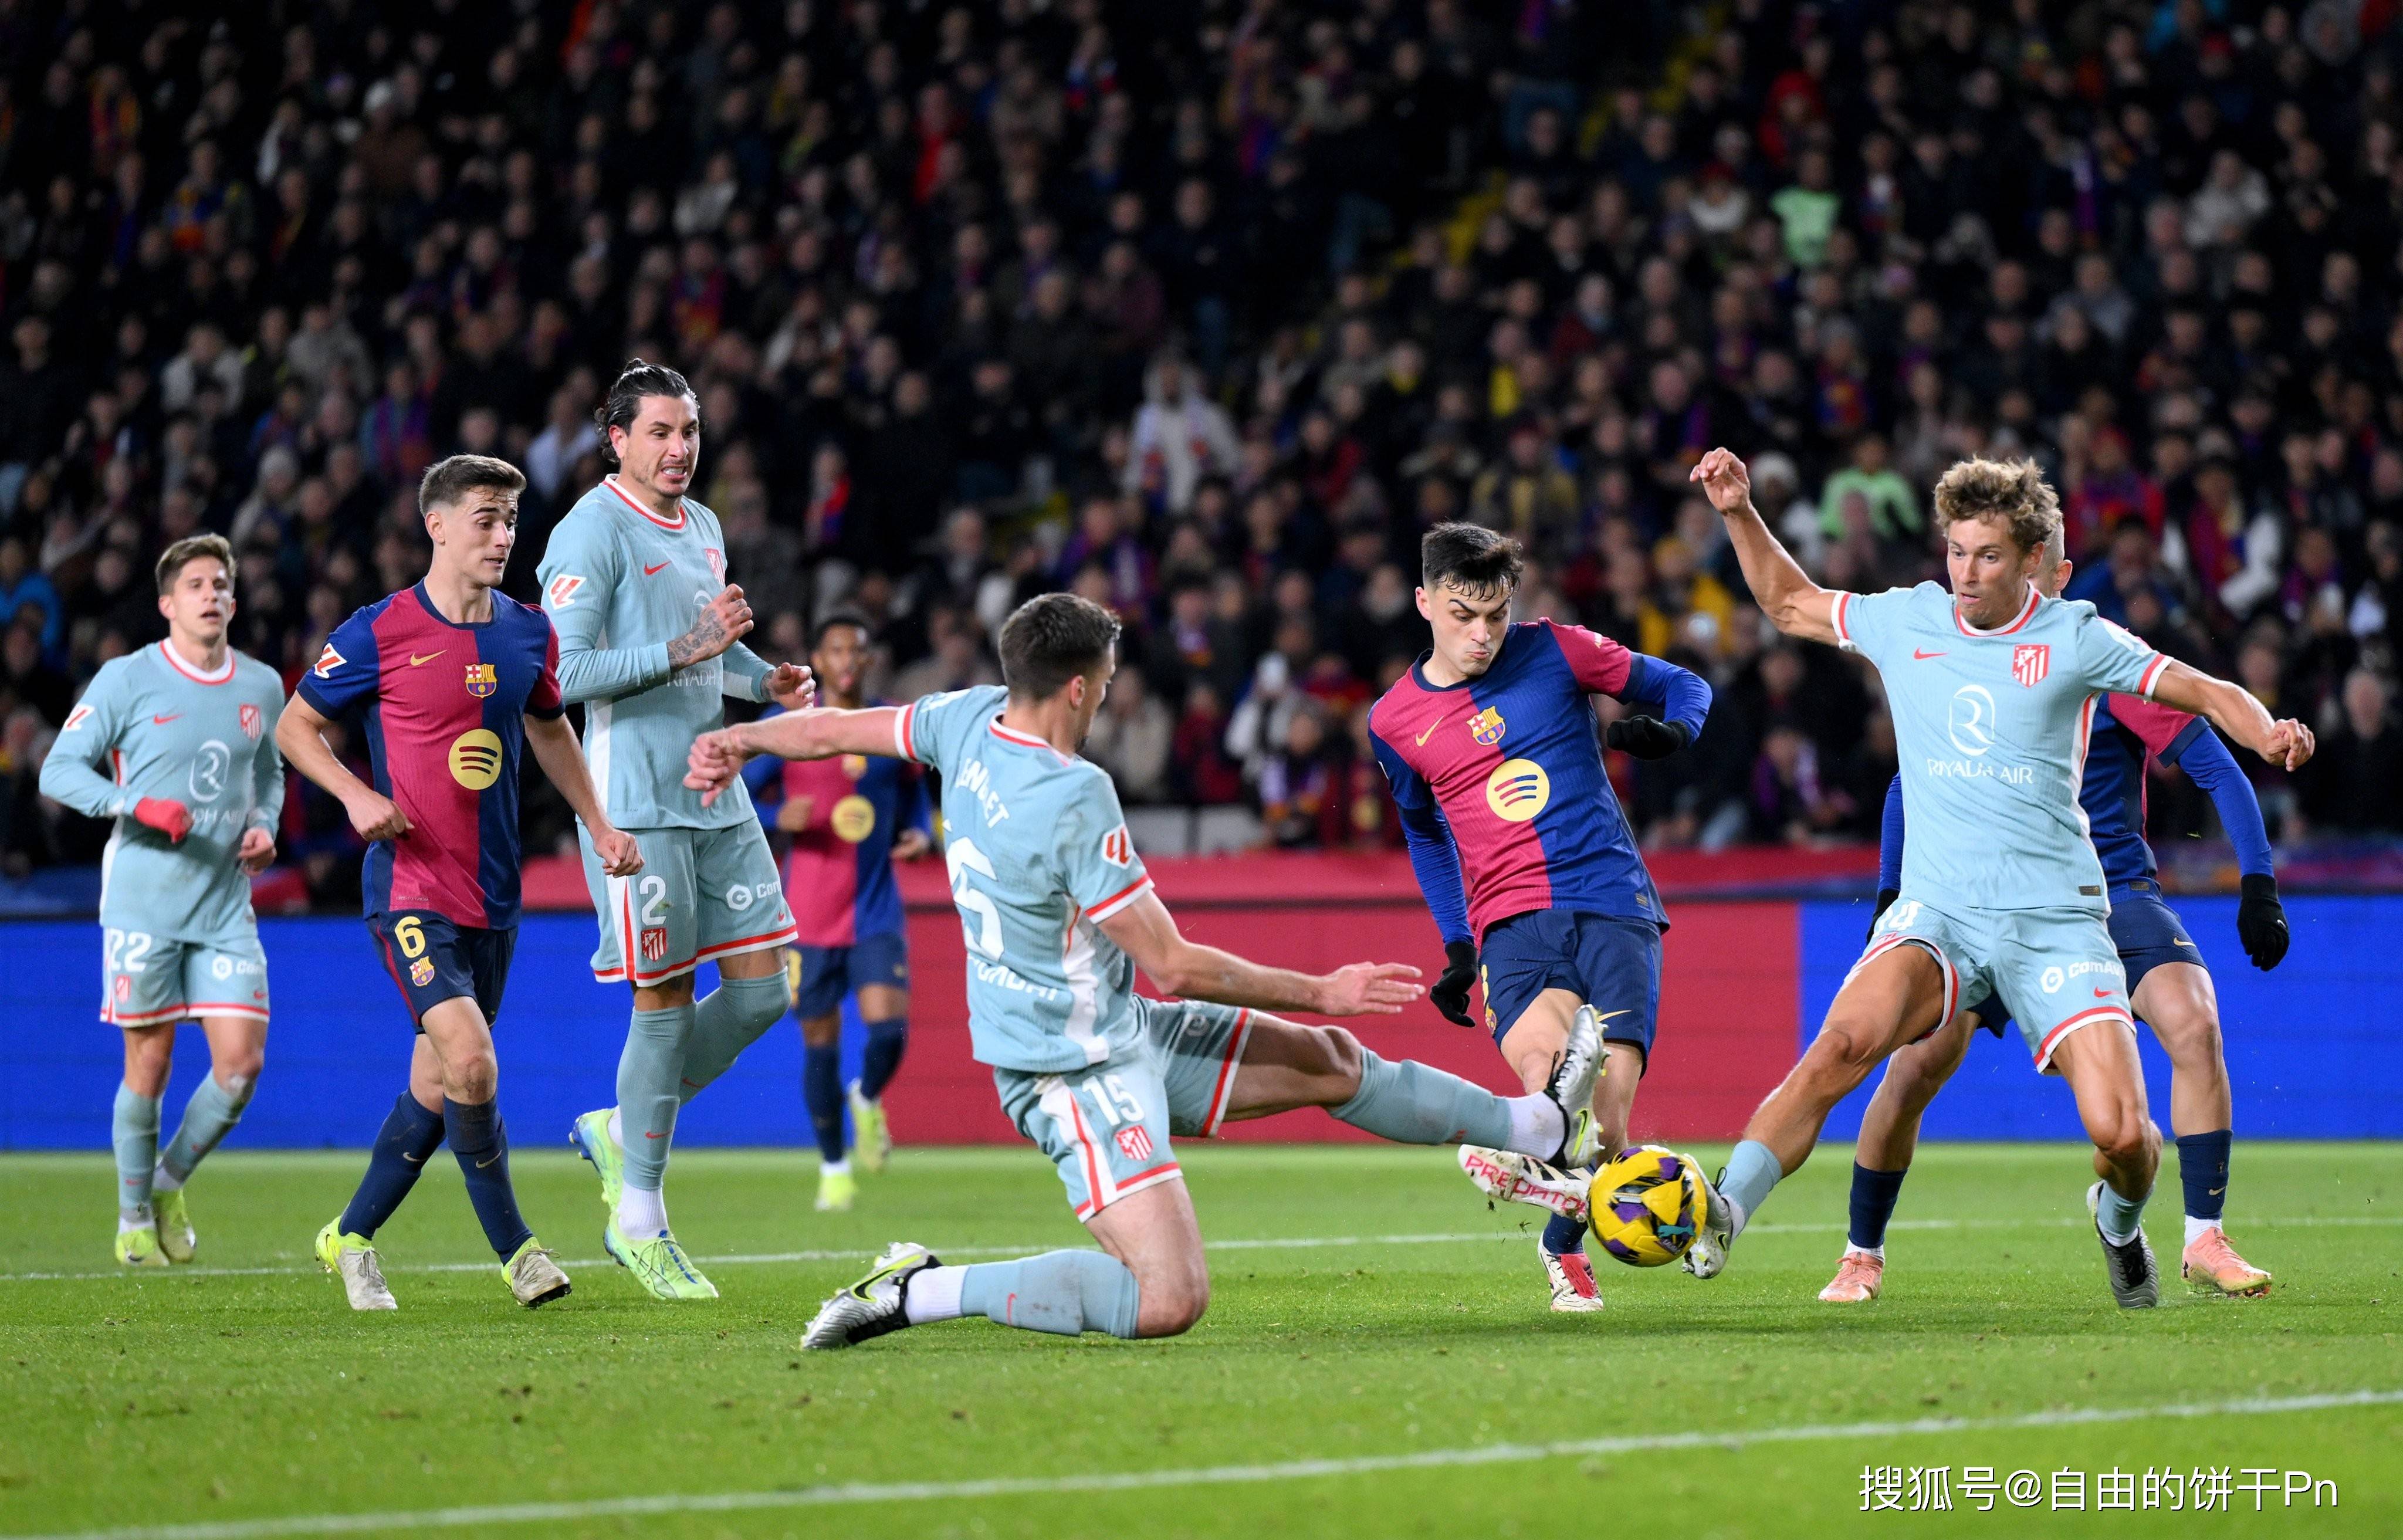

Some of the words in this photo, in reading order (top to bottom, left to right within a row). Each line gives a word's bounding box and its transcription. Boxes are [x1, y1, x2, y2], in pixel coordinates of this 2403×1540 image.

[2000, 766, 2034, 784] AIR
[639, 875, 666, 926] 2
[110, 928, 151, 973] 22
[394, 916, 426, 958] 6
[1082, 1074, 1145, 1126] 15
